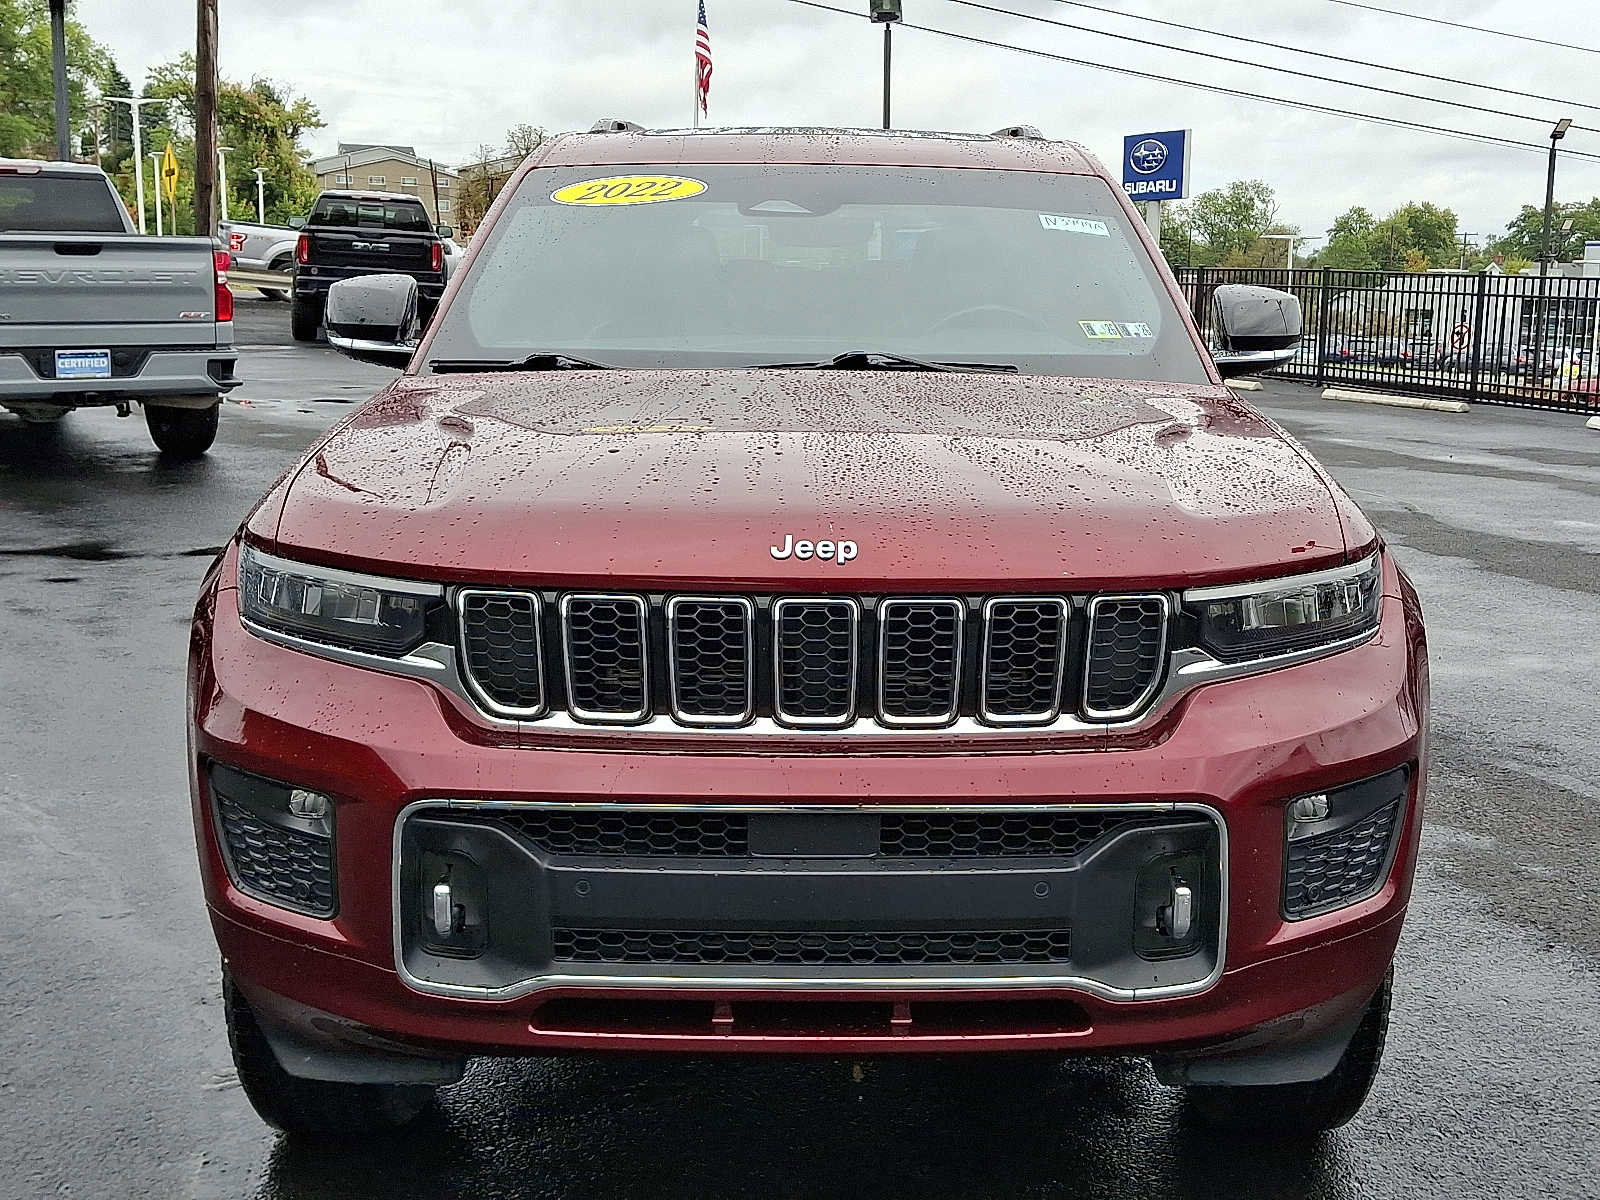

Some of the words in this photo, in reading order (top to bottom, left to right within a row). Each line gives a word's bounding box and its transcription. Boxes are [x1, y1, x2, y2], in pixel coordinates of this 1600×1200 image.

[576, 181, 682, 201] 2022
[1124, 179, 1177, 195] SUBARU
[58, 358, 108, 368] CERTIFIED
[769, 533, 859, 566] Jeep
